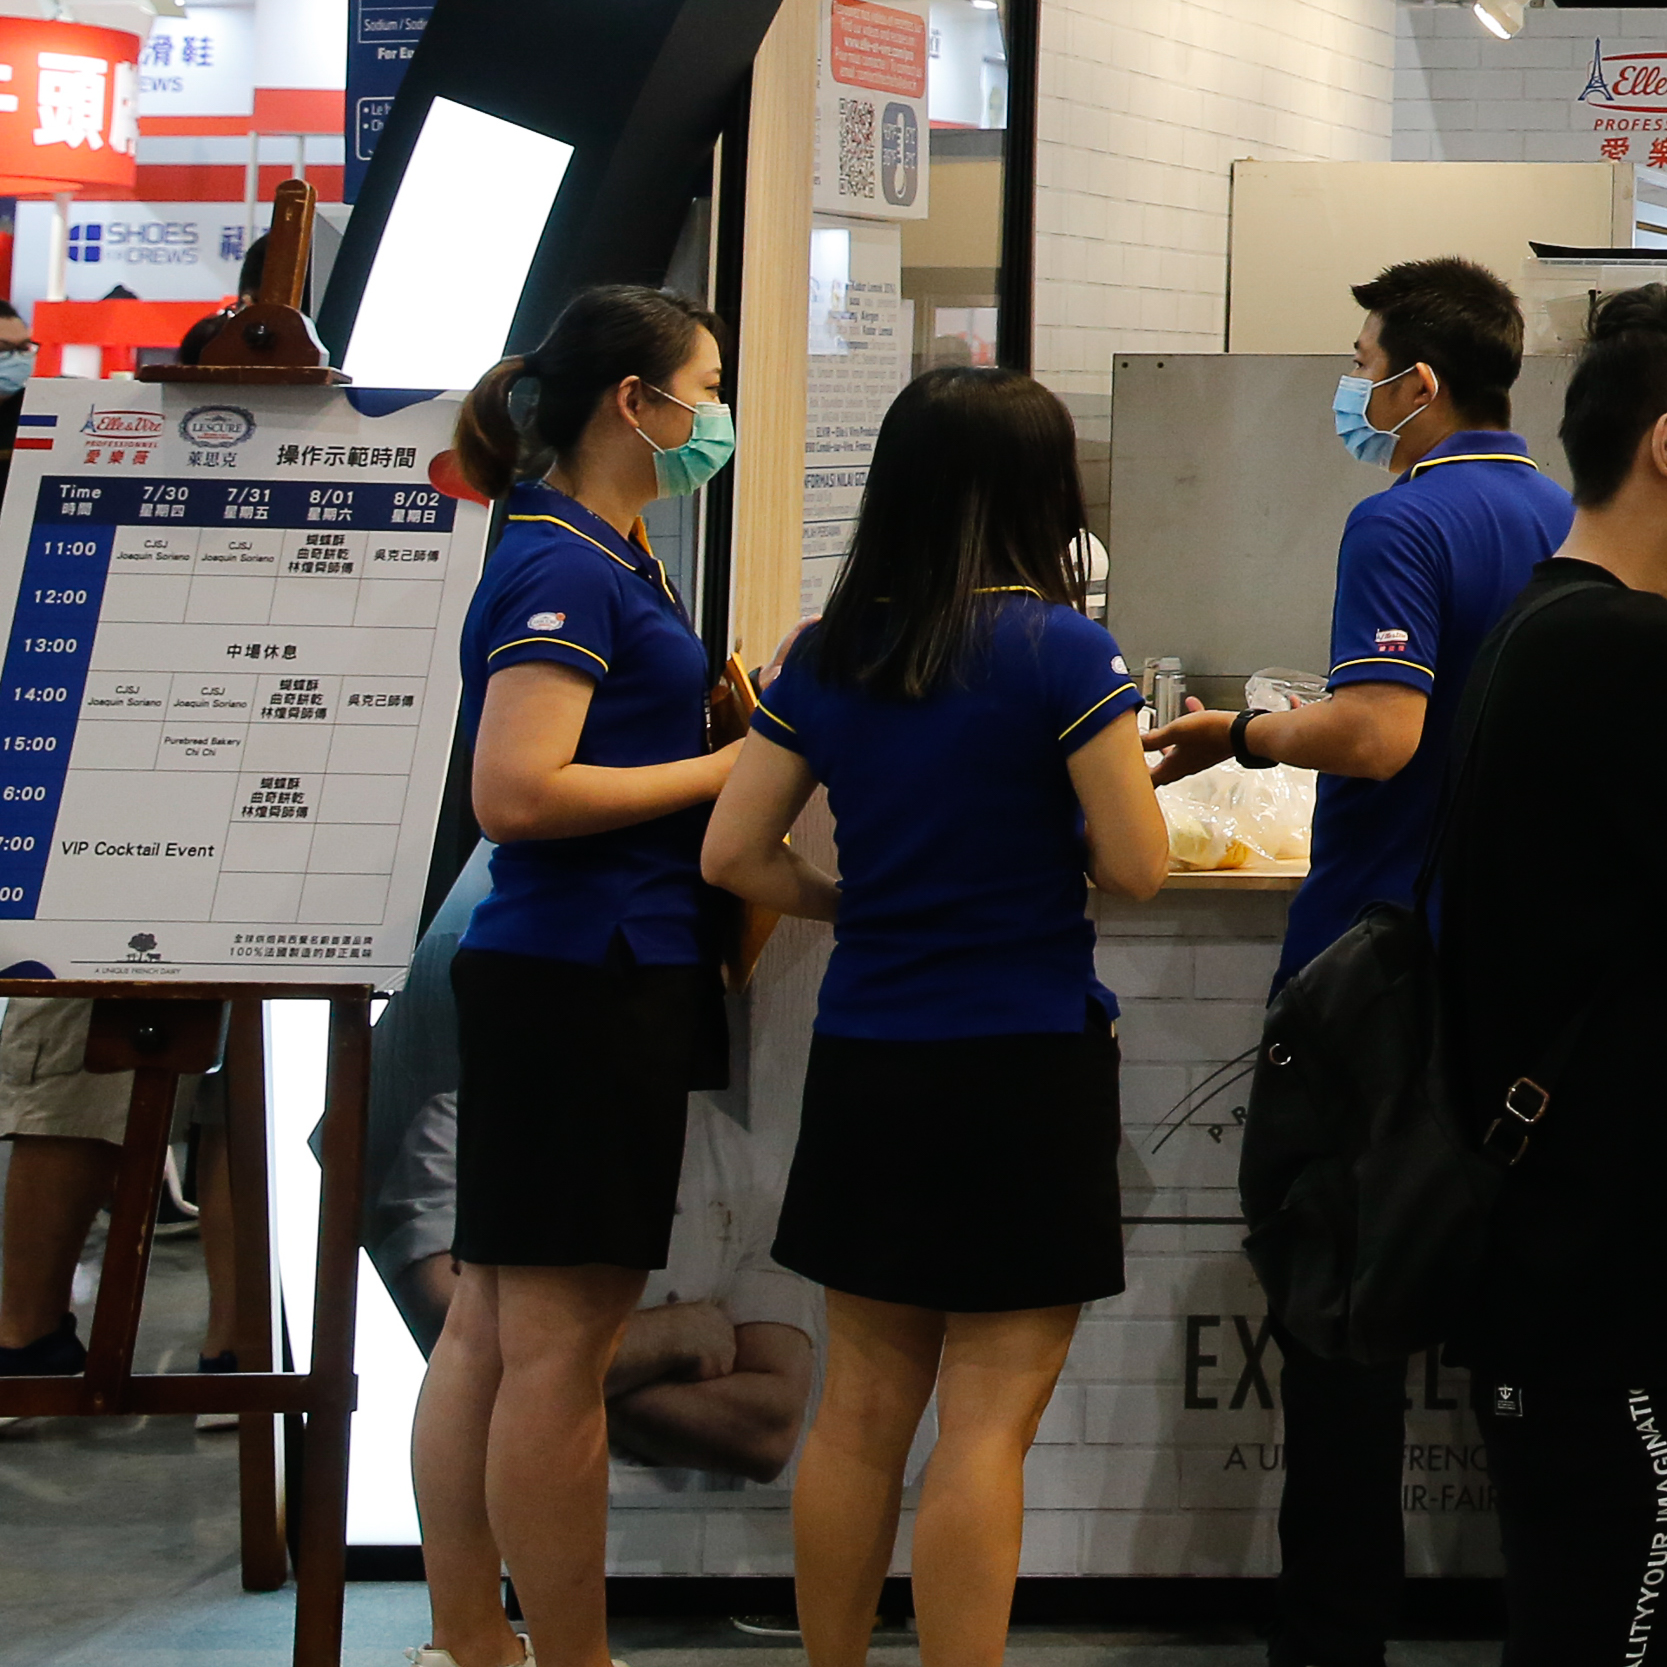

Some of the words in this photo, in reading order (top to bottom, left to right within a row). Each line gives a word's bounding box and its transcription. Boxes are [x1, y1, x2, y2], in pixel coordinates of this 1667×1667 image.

[108, 222, 199, 245] SHOES
[126, 247, 199, 264] CREWS
[192, 422, 243, 433] LESCURE
[276, 444, 417, 468] 操作示範時間
[59, 485, 102, 499] Time
[142, 485, 189, 501] 7/30
[227, 487, 271, 503] 7/31
[309, 489, 354, 505] 8/01
[393, 491, 440, 507] 8/02
[61, 502, 93, 516] 時間
[139, 503, 186, 518] 星期四
[223, 505, 270, 520] 星期五
[307, 506, 353, 522] 星期六
[391, 508, 437, 524] 星期日
[44, 541, 97, 556] 11:00
[34, 590, 88, 604] 12:00
[24, 638, 78, 653] 13:00
[226, 644, 298, 660] 中場休息
[14, 687, 67, 702] 14:00
[3, 736, 57, 751] 15:00
[2, 786, 46, 801] 6:00
[62, 841, 89, 856] VIP
[94, 841, 160, 857] Cocktail
[165, 842, 215, 857] Event
